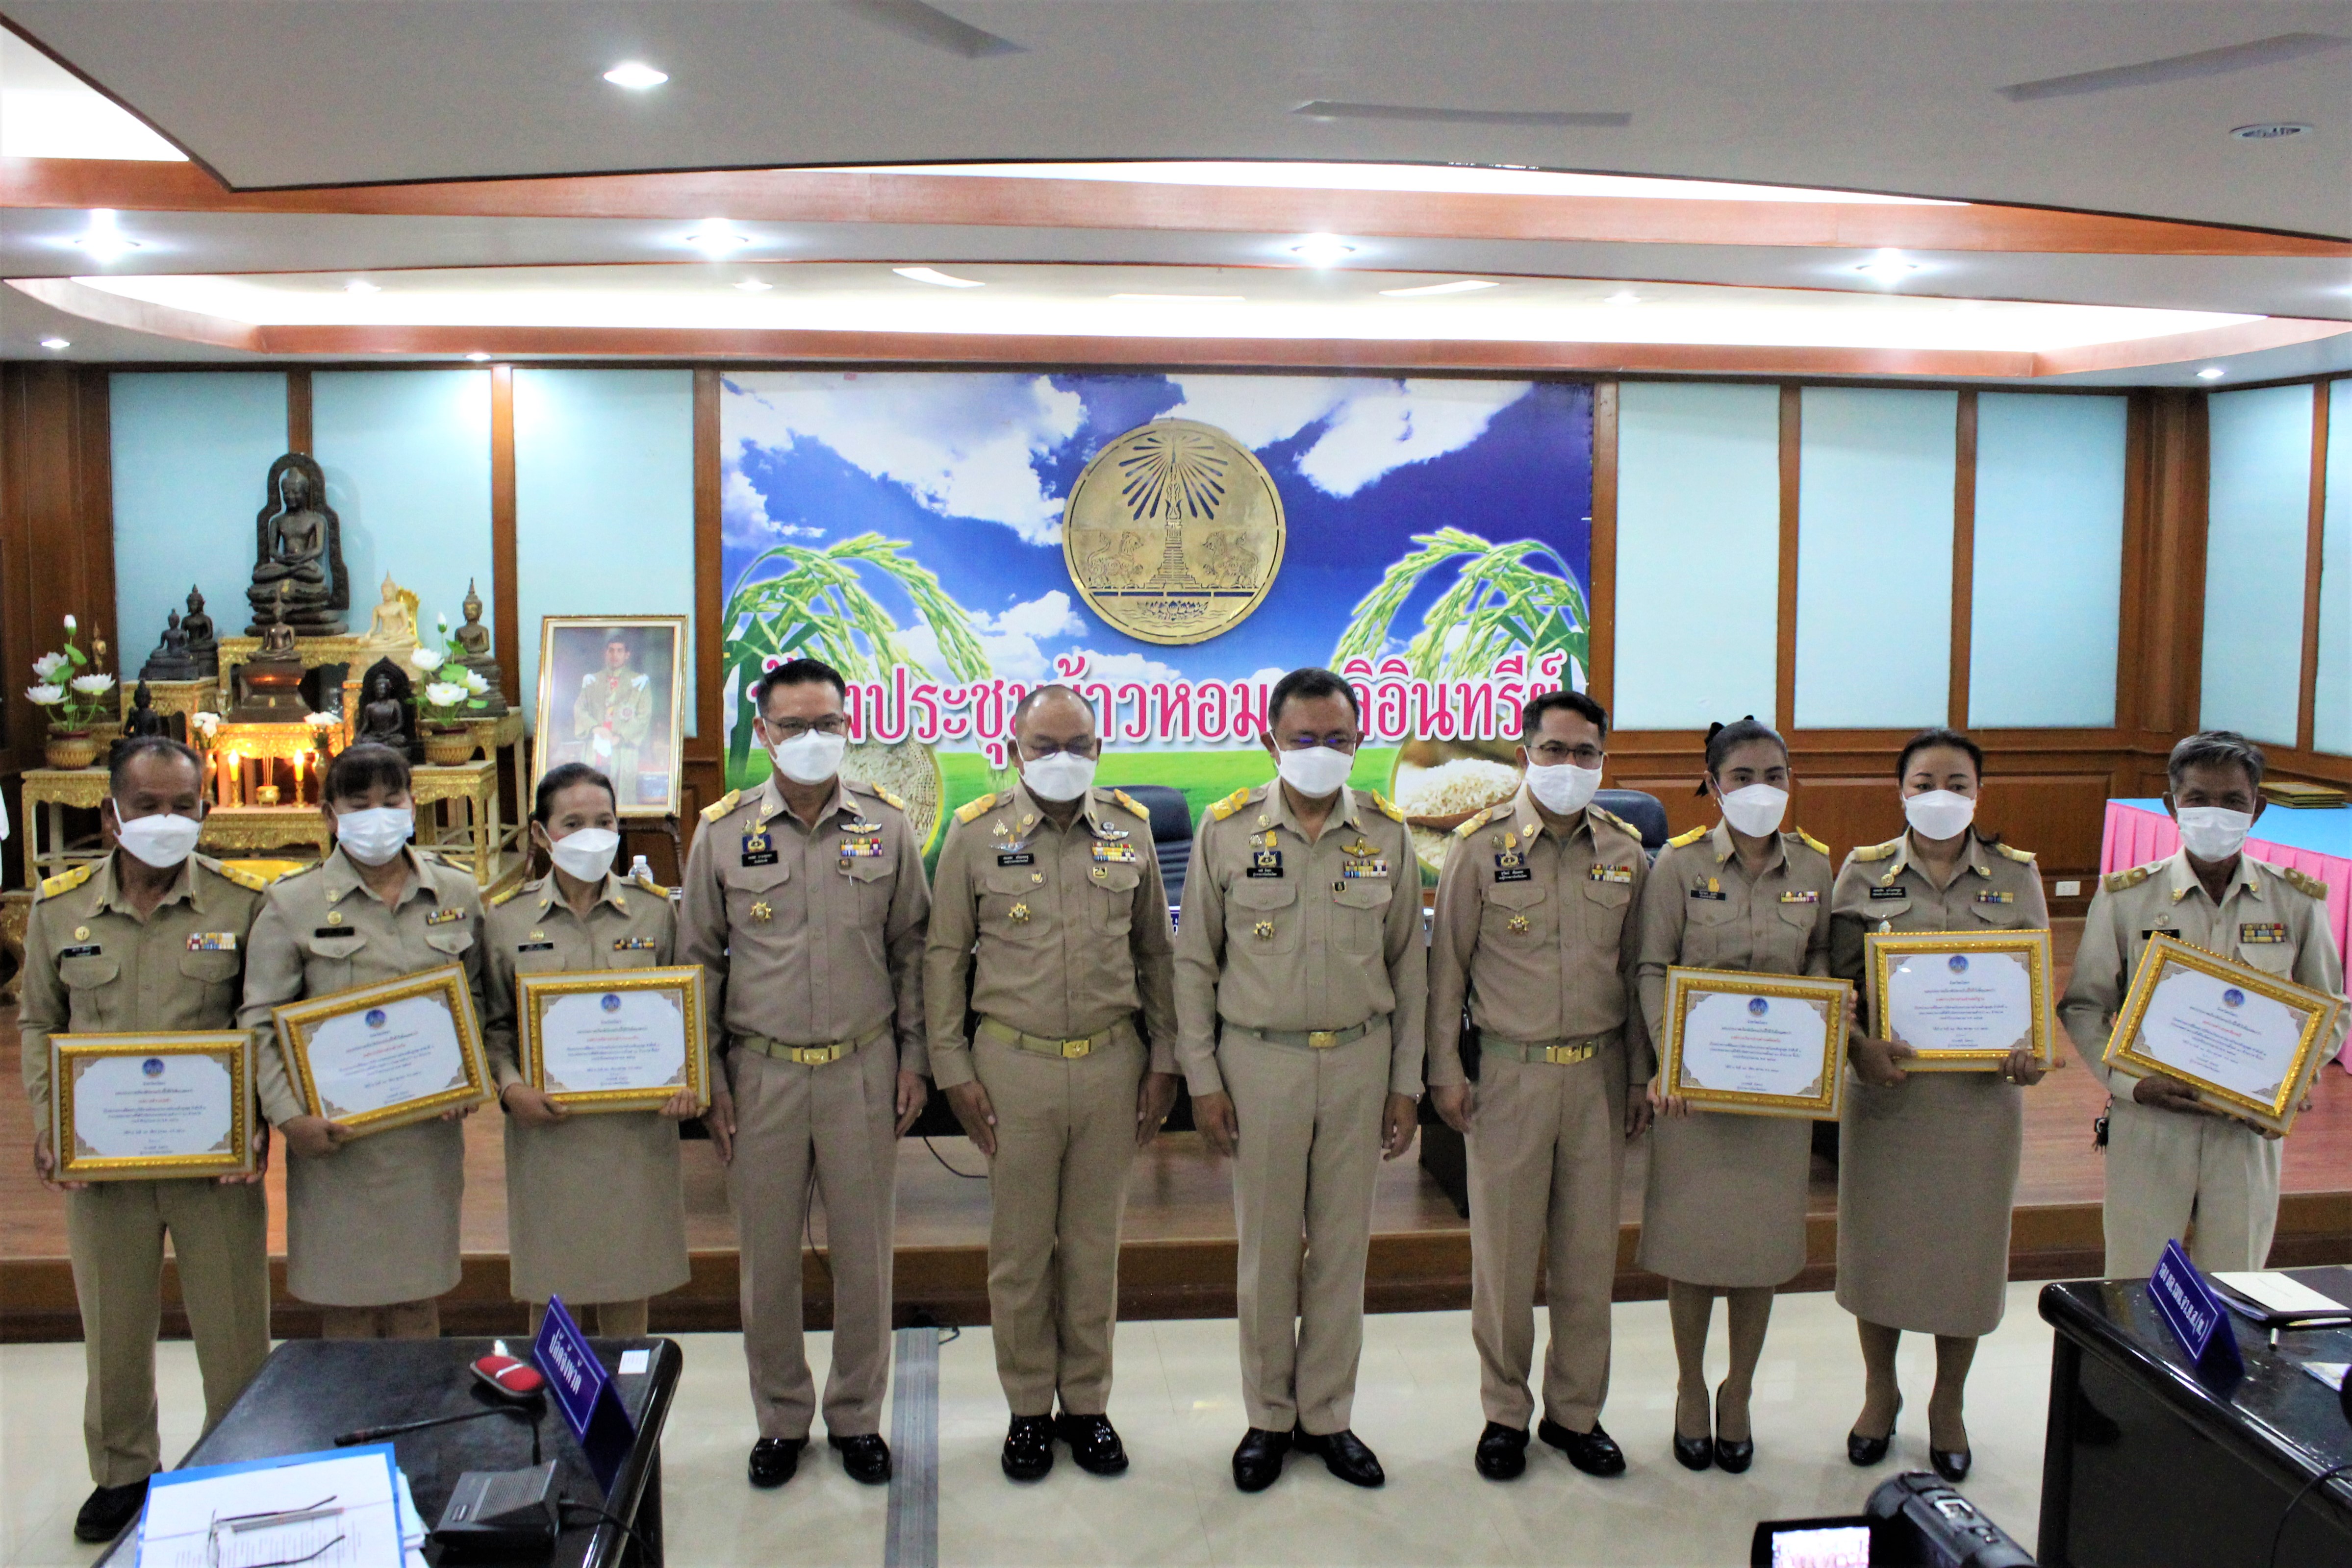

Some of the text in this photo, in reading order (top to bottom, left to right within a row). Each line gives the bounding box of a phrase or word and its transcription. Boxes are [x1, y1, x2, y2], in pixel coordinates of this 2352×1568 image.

[548, 1327, 583, 1396] ปลัดจังหวัด
